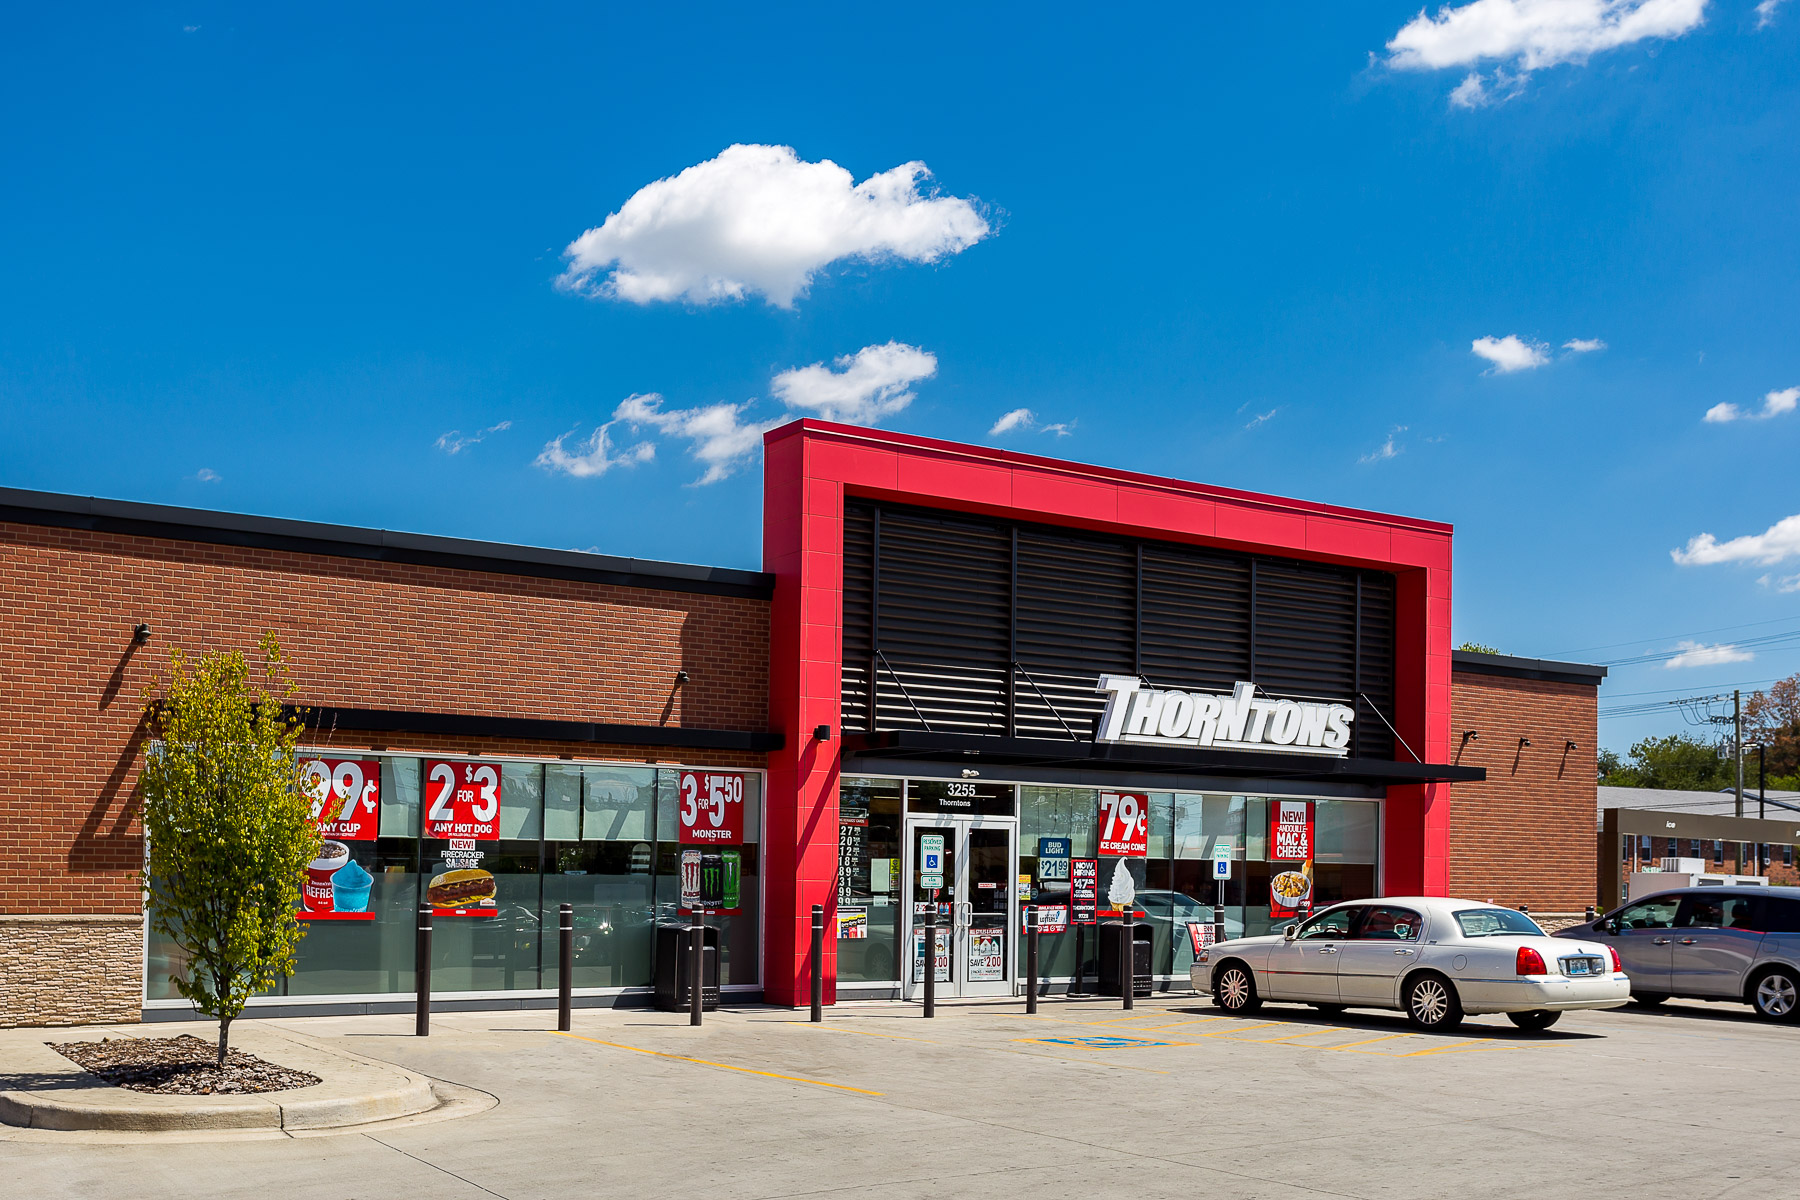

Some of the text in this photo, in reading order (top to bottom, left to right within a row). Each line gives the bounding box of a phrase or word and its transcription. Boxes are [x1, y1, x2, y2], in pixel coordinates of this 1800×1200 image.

[1097, 674, 1355, 750] THORNTONS
[428, 764, 498, 822] 2 FOR $3
[948, 783, 976, 796] 3255
[681, 774, 698, 826] 3
[698, 798, 708, 810] FOR
[939, 798, 971, 807] Thorntons
[1101, 794, 1146, 841] 79¢
[1282, 811, 1304, 823] NEW!
[316, 822, 361, 832] ANY CUP
[434, 823, 492, 834] ANY HOT DOG
[692, 830, 731, 838] MONSTER
[1277, 832, 1308, 846] MAC &
[452, 840, 473, 849] NEW!
[1110, 842, 1130, 850] CREAM
[1277, 846, 1308, 858] CHEESE
[446, 858, 479, 868] SAUSAGE
